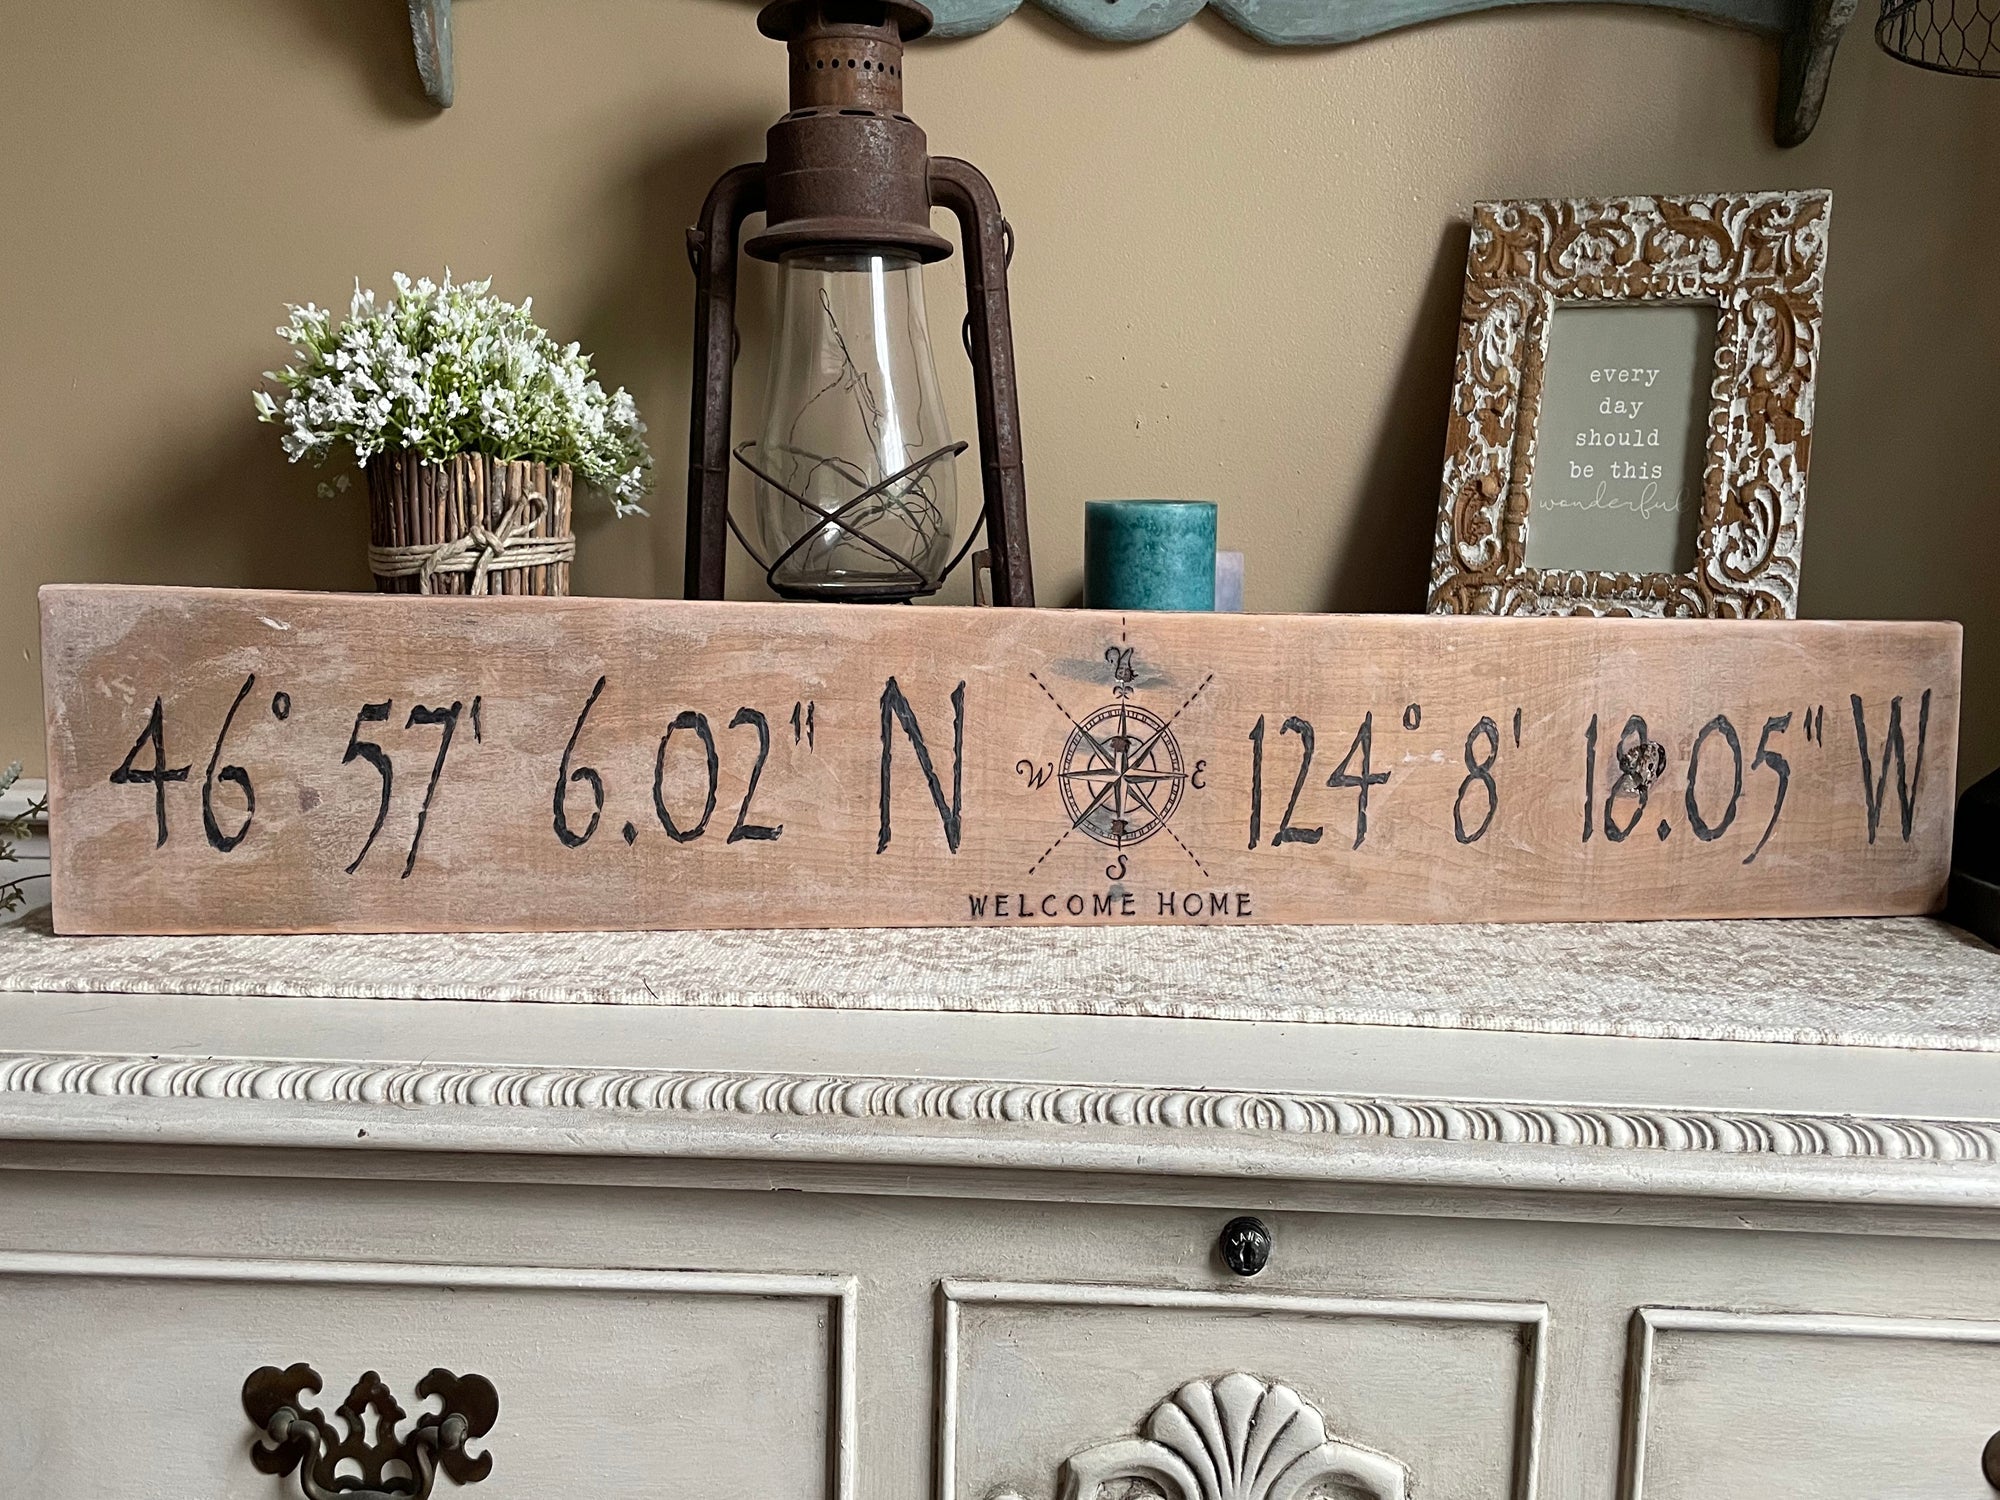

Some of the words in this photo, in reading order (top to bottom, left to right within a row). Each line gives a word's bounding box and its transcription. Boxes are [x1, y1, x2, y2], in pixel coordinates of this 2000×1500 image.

[1589, 367, 1660, 388] every
[1599, 397, 1644, 419] day
[1575, 428, 1660, 447] should
[1569, 461, 1594, 479] be
[1610, 461, 1663, 480] this
[876, 674, 966, 855] N
[1850, 688, 1932, 845] W
[1105, 853, 1129, 881] S
[969, 891, 1137, 918] WELCOME
[1157, 890, 1254, 917] HOME
